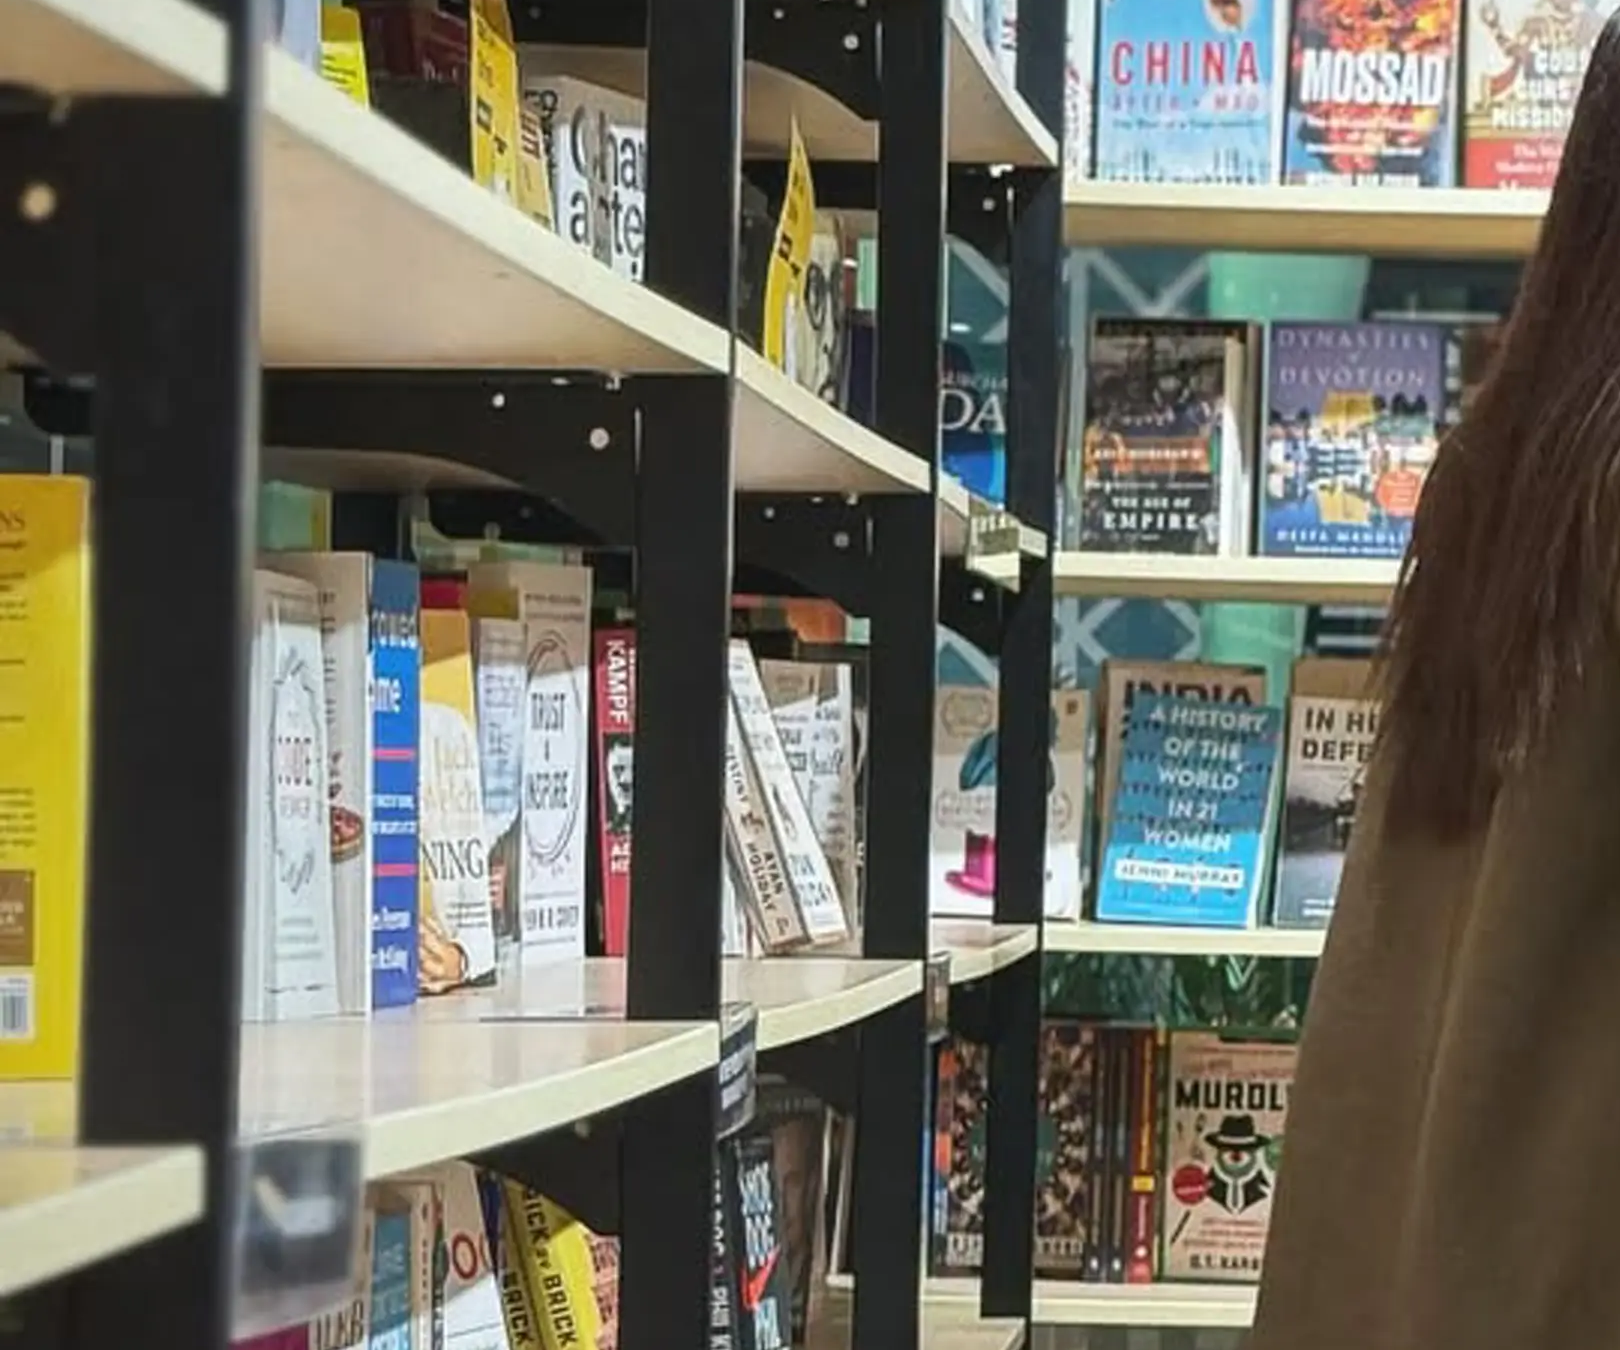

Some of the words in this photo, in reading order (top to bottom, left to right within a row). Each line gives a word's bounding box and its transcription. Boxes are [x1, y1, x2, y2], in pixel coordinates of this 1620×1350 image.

[1112, 40, 1259, 86] CHINA
[1302, 47, 1444, 106] MOSSAD
[1278, 329, 1430, 350] DYNASTIES
[1279, 366, 1425, 388] DEVOTION
[1102, 513, 1201, 531] EMPIRE
[605, 639, 630, 725] KAMPF
[531, 692, 568, 731] TRUST
[1172, 708, 1269, 734] HISTORY
[1304, 707, 1336, 731] IN
[1164, 736, 1192, 758] OF
[1199, 742, 1242, 762] THE
[1156, 765, 1241, 792] WORLD
[1168, 801, 1193, 818] IN
[1196, 801, 1219, 820] 21
[1143, 828, 1232, 854] WOMEN
[1175, 1078, 1290, 1112] MURDL
[541, 1271, 578, 1348] BRICK
